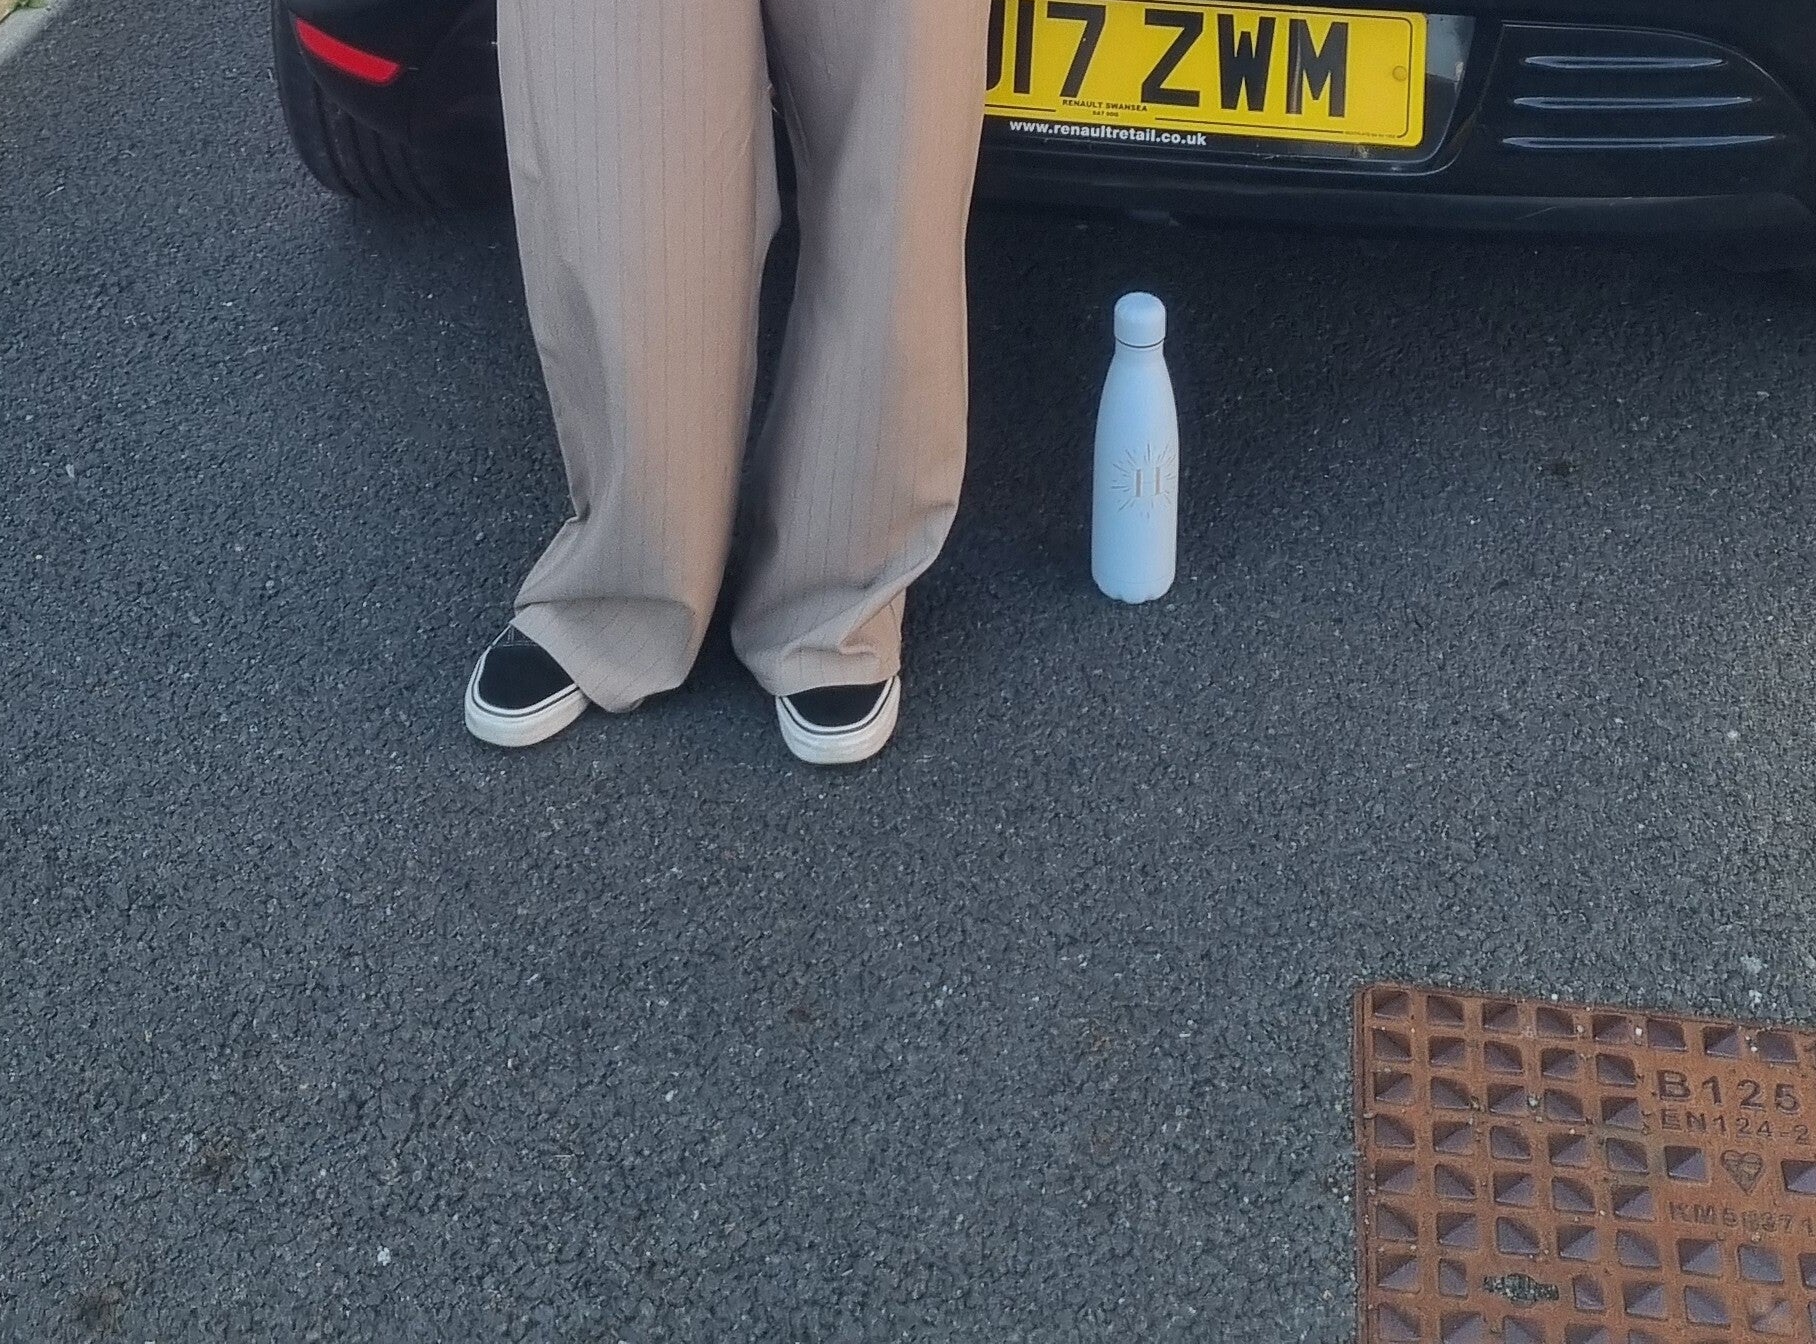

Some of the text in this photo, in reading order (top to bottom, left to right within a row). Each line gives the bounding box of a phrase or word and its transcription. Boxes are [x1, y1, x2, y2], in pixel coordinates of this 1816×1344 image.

[1140, 8, 1349, 119] ZWM
[1062, 99, 1148, 112] RENAULT SWANSEA
[1009, 120, 1207, 146] www.renaultretail.co.uk
[1656, 1069, 1800, 1115] B125
